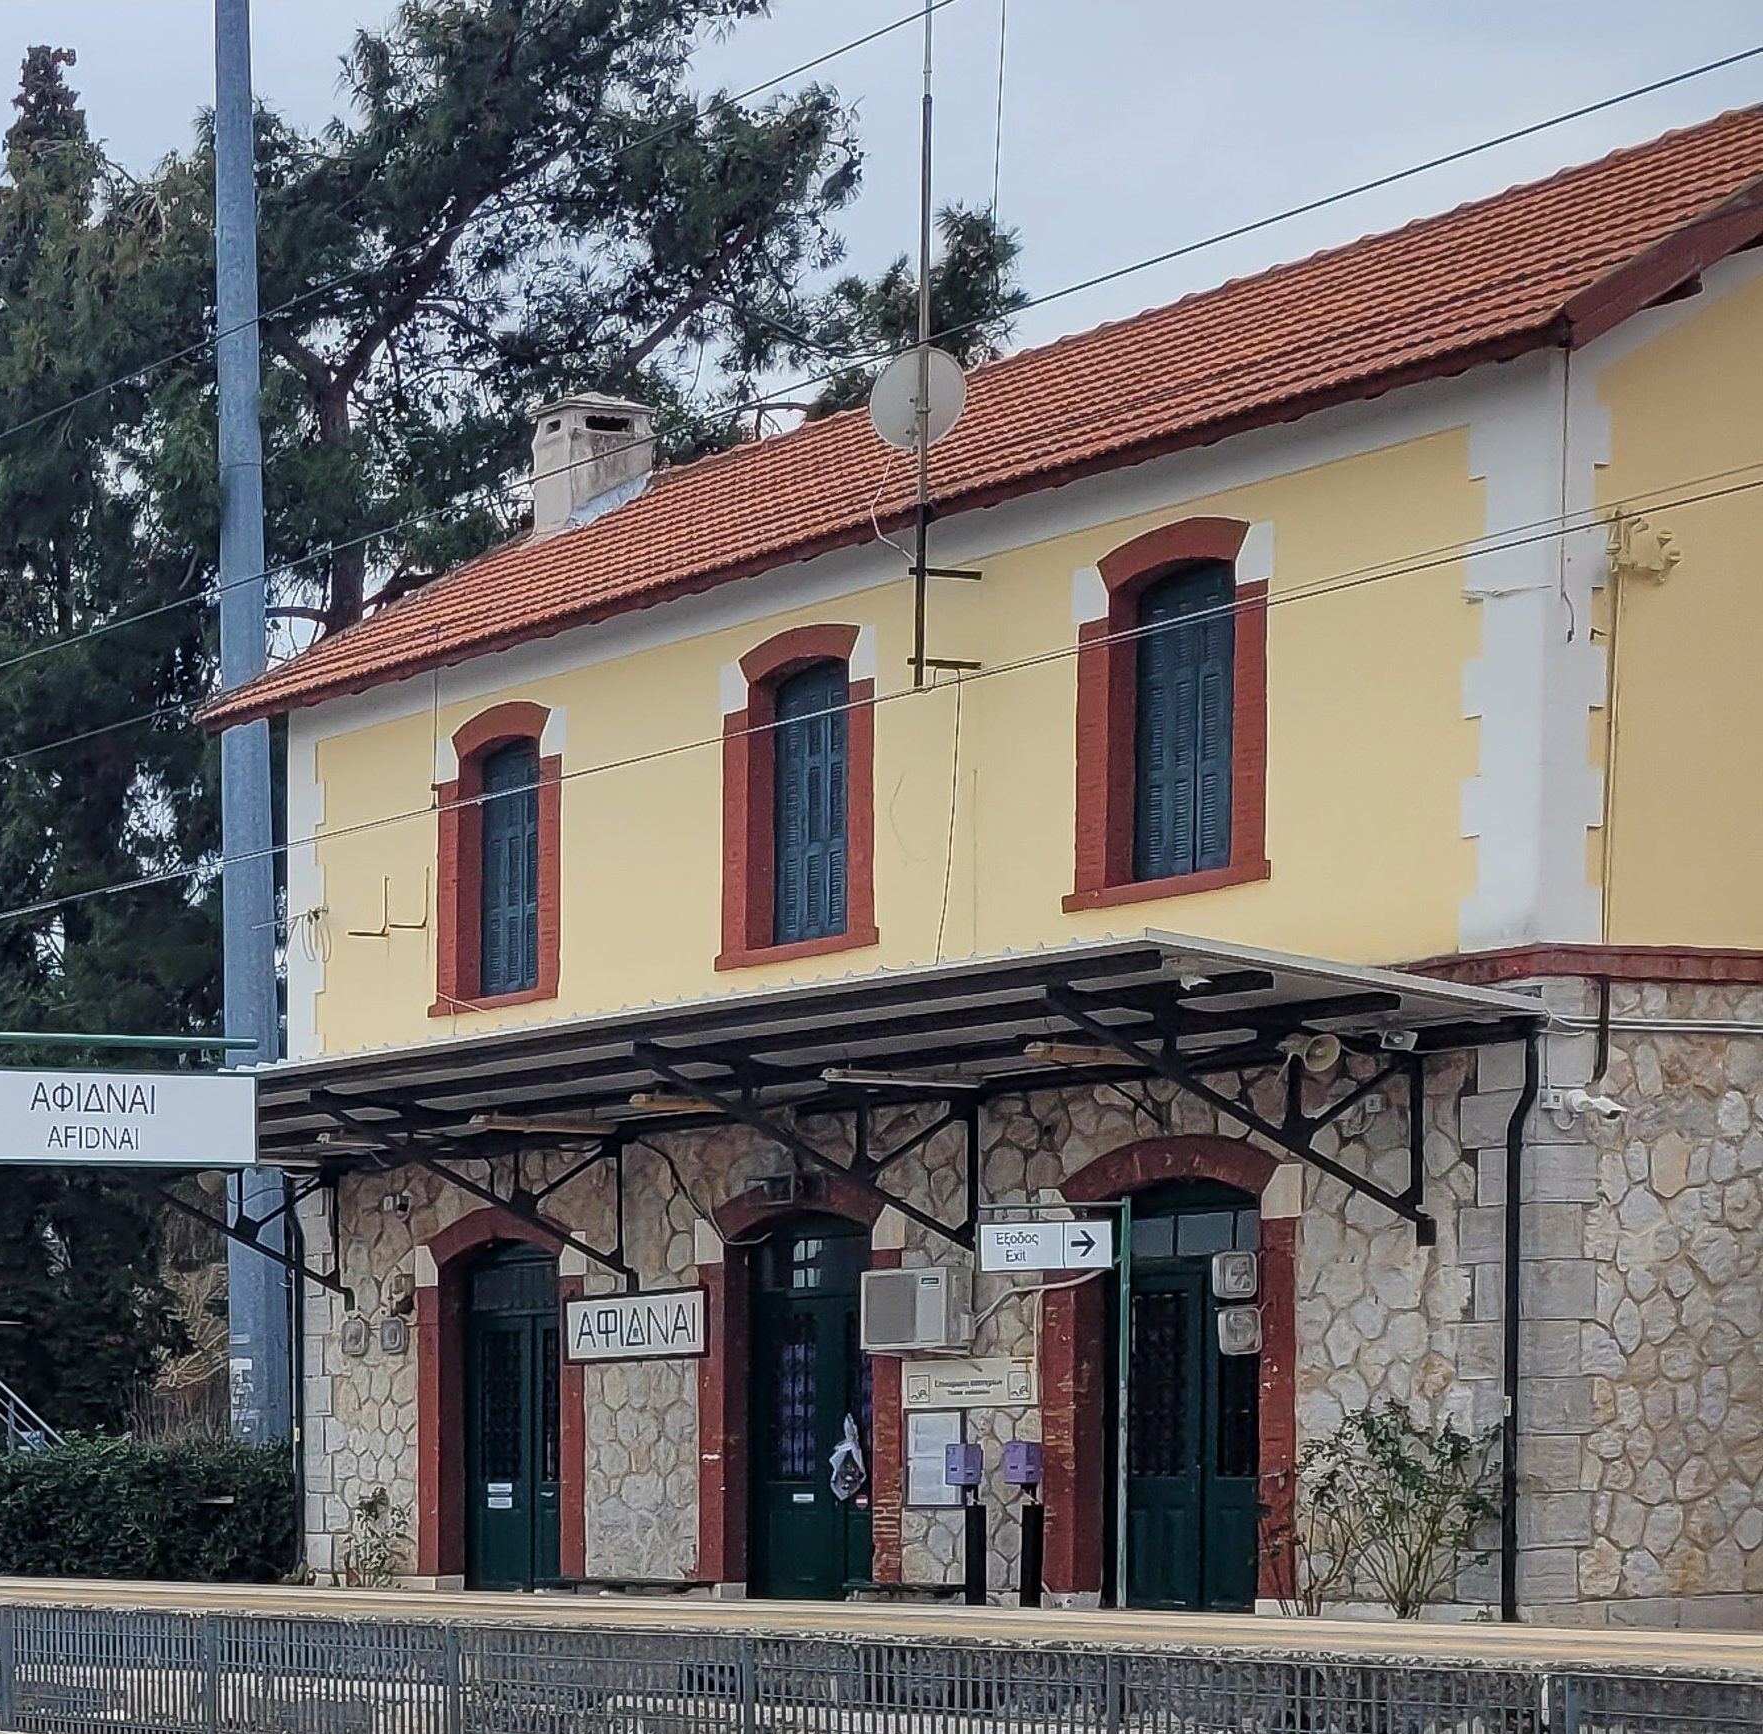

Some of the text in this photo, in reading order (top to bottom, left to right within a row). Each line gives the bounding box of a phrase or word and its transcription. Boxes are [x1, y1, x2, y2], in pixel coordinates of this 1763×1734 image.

[30, 1081, 157, 1115] ΑΦΙΔΝΑΙ
[46, 1125, 141, 1151] AFIDNAI
[994, 1232, 1039, 1247] Έξοδος
[1005, 1250, 1027, 1262] Exit
[576, 1302, 696, 1349] ΑΦΙΔΝΑΙ
